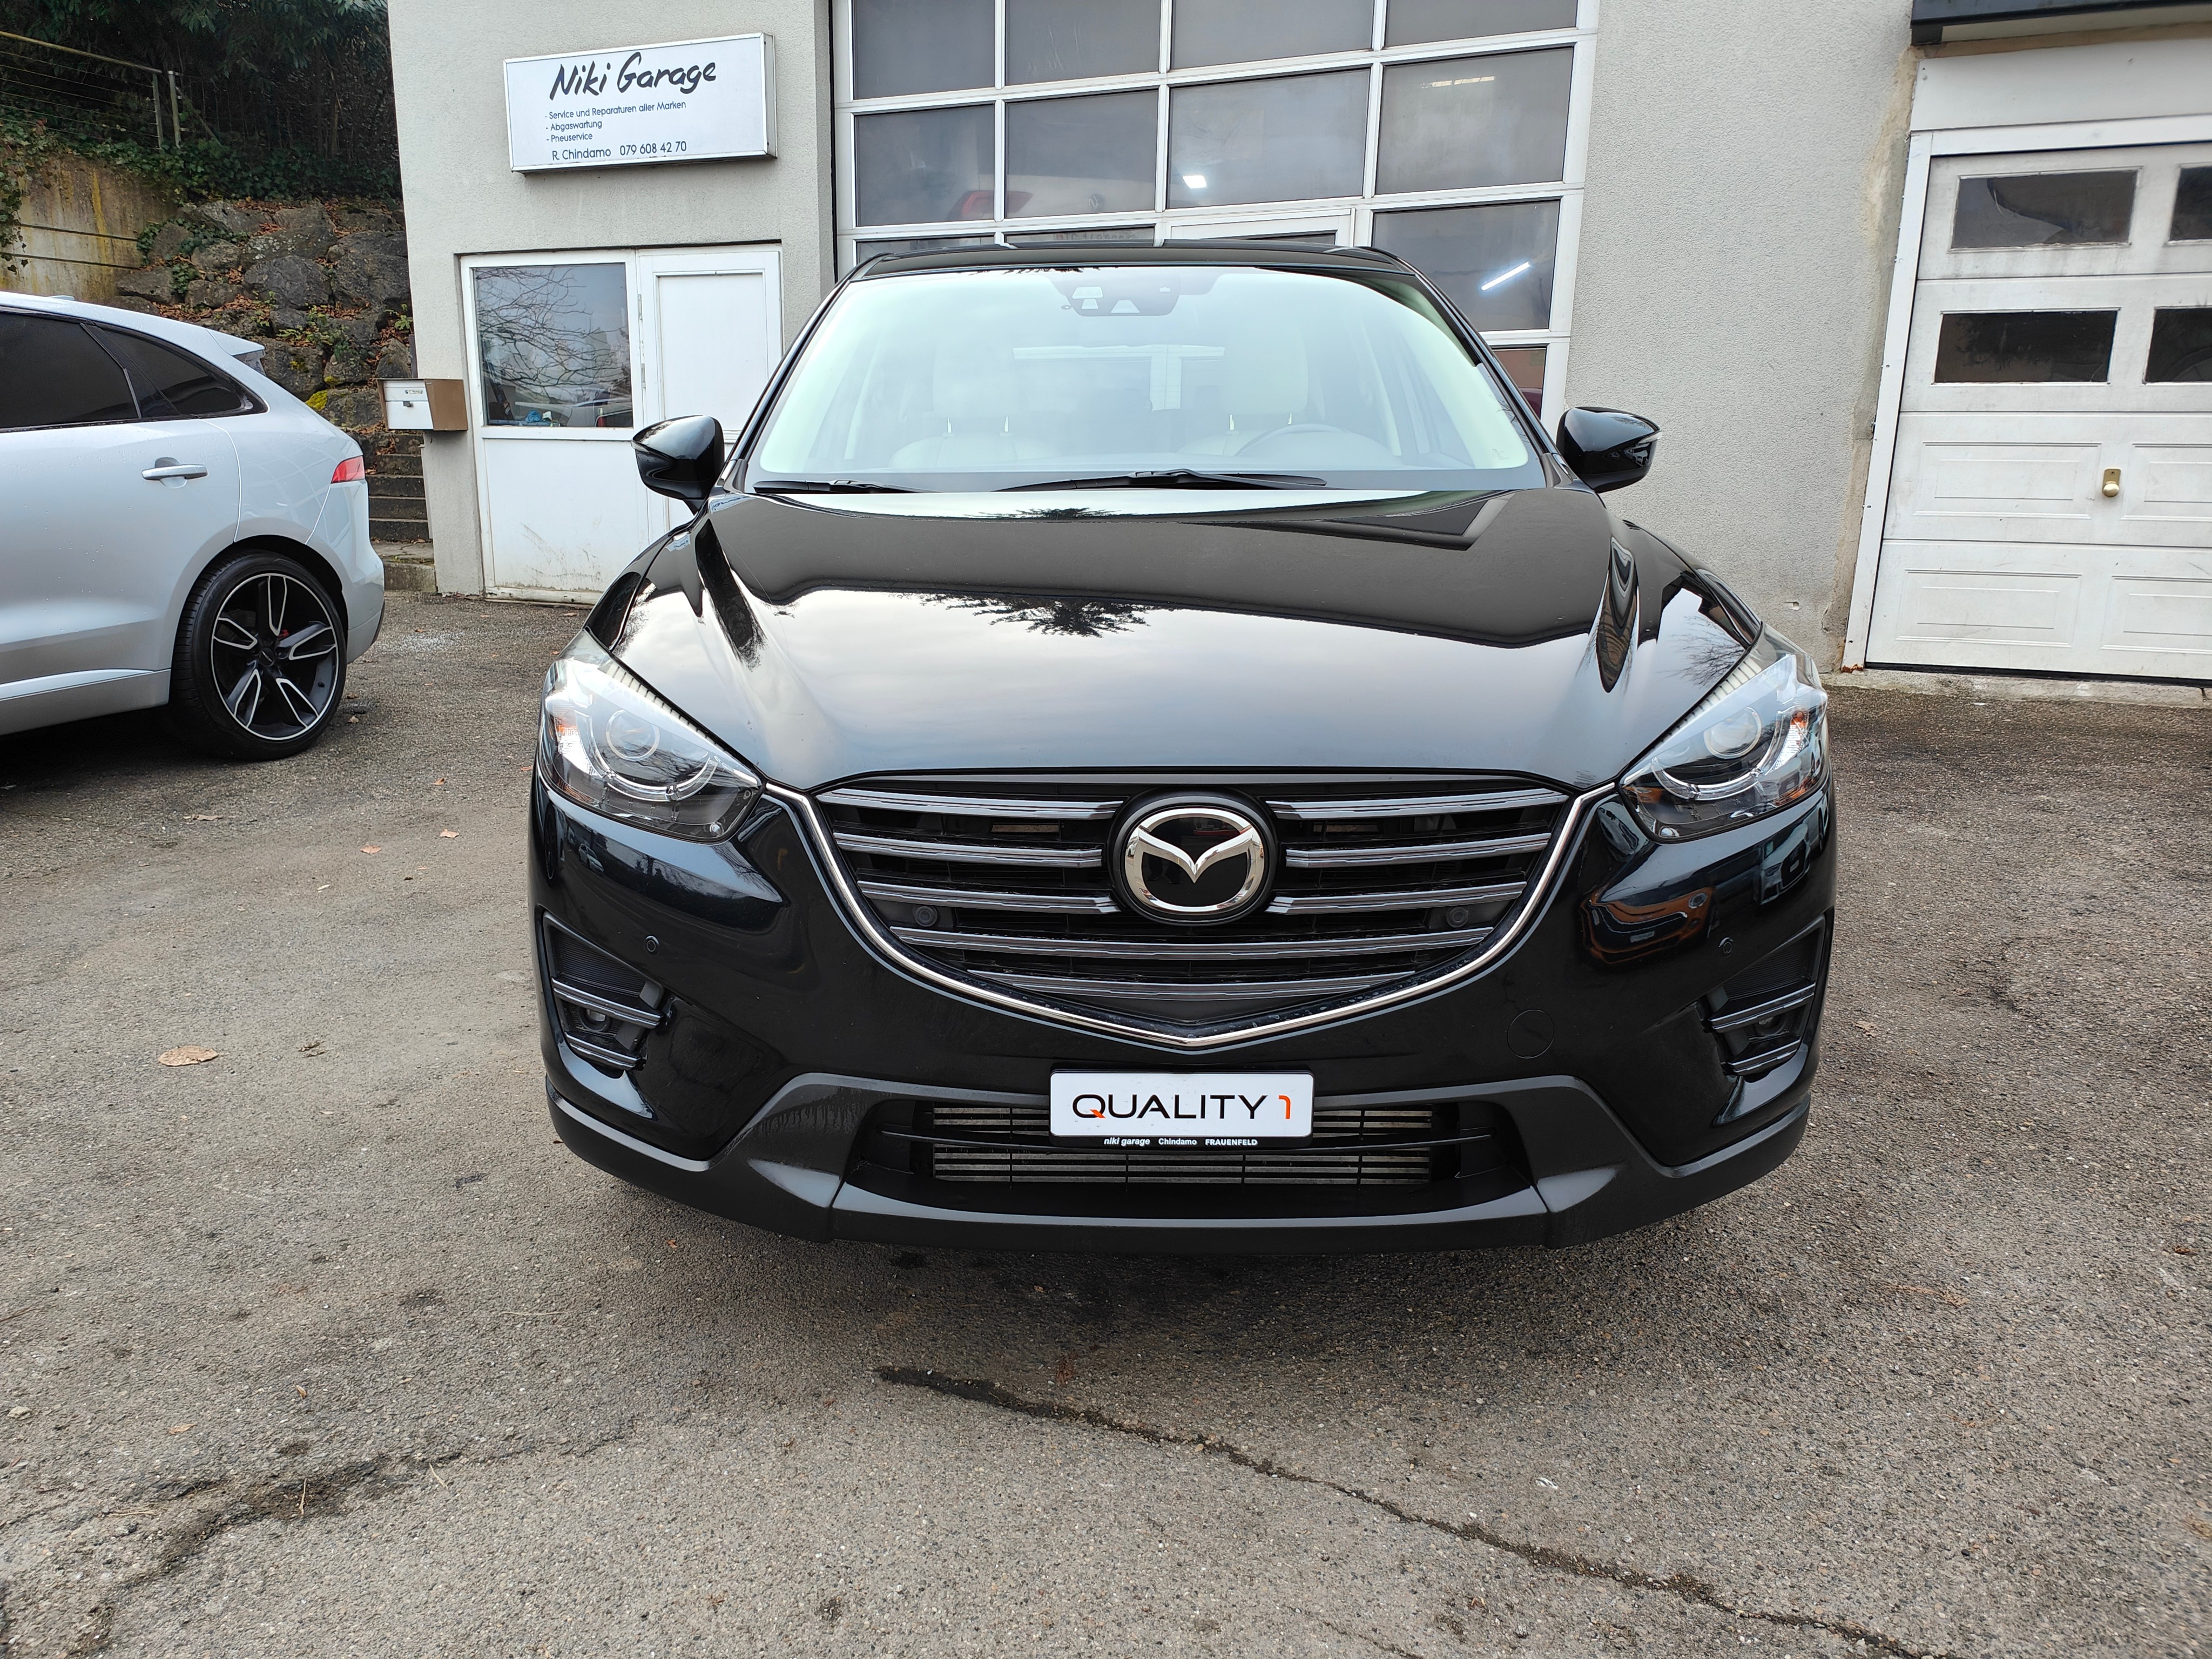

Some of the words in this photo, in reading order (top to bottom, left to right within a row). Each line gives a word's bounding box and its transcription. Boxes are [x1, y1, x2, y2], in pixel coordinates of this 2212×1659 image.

[549, 60, 611, 101] Niki
[617, 52, 717, 95] Garage
[549, 110, 574, 120] Service
[576, 108, 590, 117] und
[592, 105, 637, 117] Reparaturen
[639, 103, 655, 112] aller
[657, 101, 686, 111] Marken
[550, 120, 602, 132] Abgaswartung
[551, 132, 593, 143] Pneuservice
[552, 150, 560, 161] R.
[562, 147, 611, 160] Chindamo
[619, 144, 637, 156] 079
[639, 143, 657, 154] 608
[660, 141, 672, 153] 42
[675, 140, 687, 152] 70
[1072, 1094, 1268, 1120] QUALITY
[1121, 1138, 1150, 1147] garage
